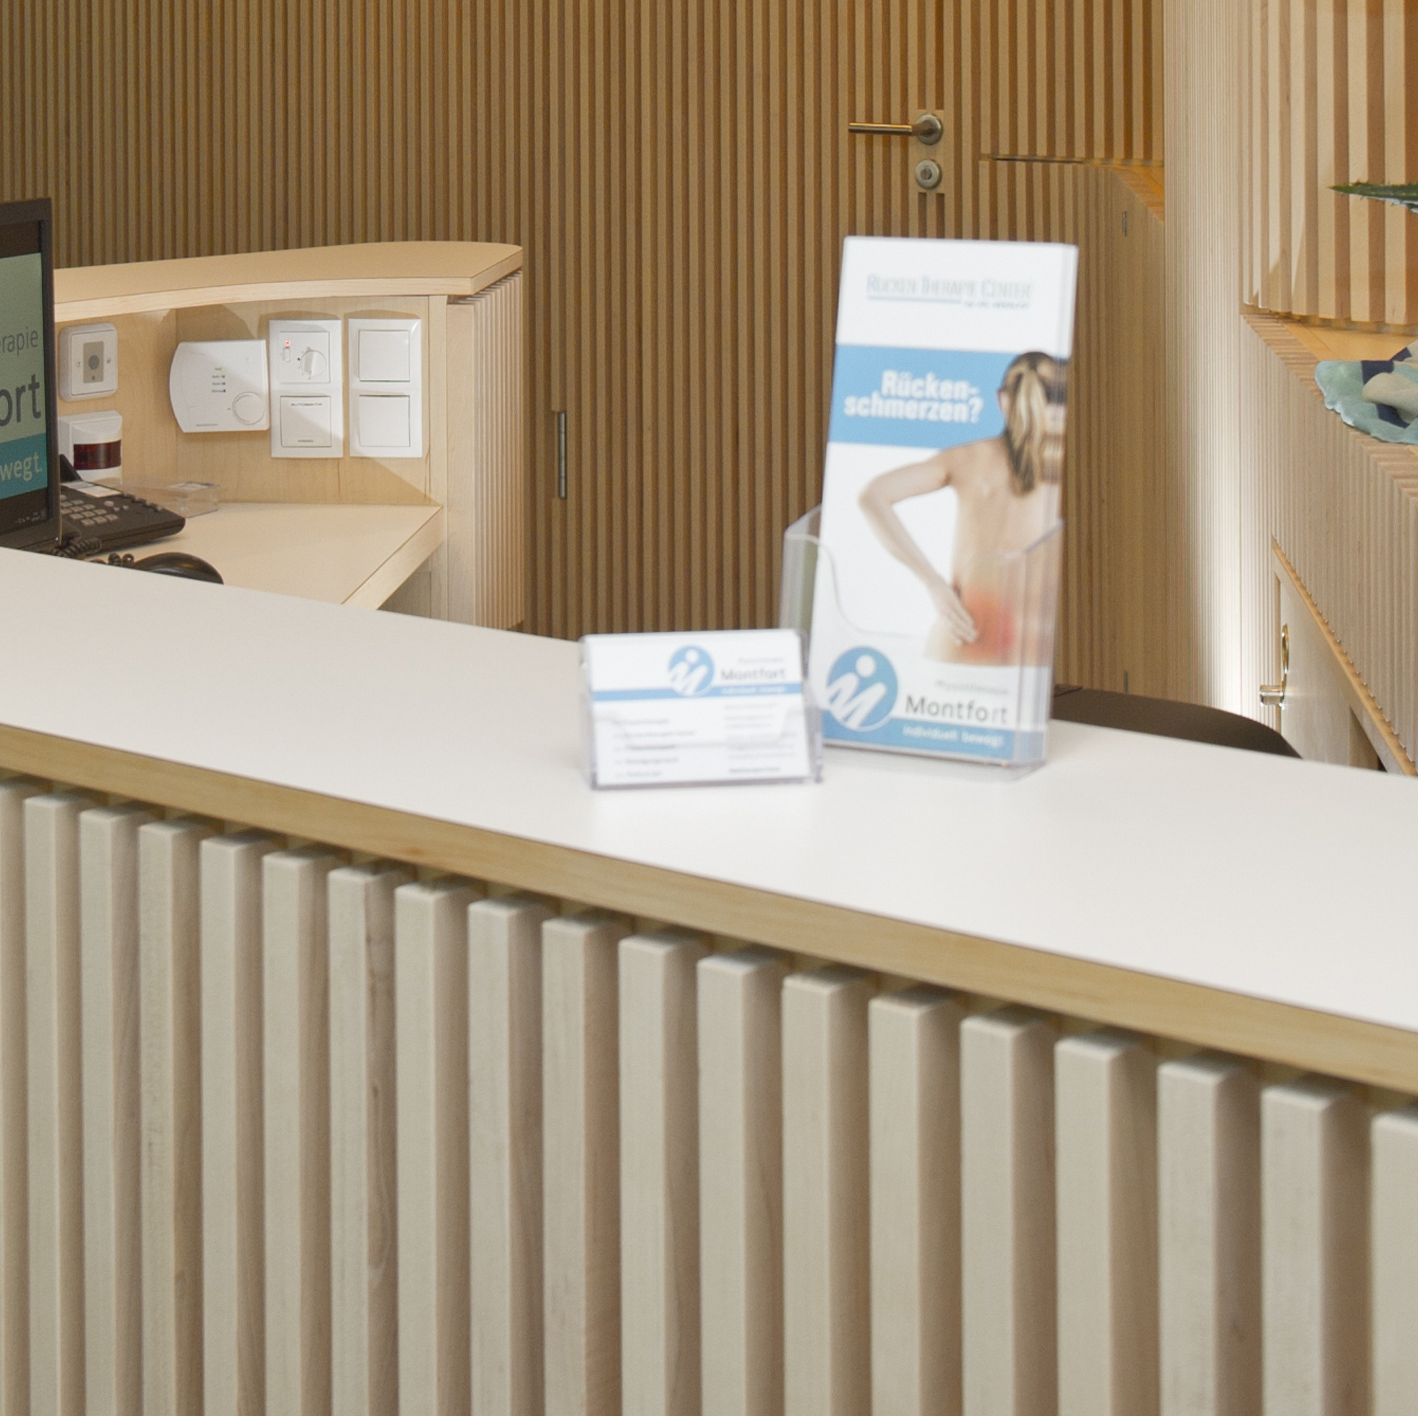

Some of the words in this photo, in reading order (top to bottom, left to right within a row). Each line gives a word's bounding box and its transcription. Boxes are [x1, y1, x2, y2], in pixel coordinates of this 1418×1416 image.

[882, 369, 980, 400] Rücken-
[843, 390, 984, 424] schmerzen?
[904, 694, 1008, 724] Montfort
